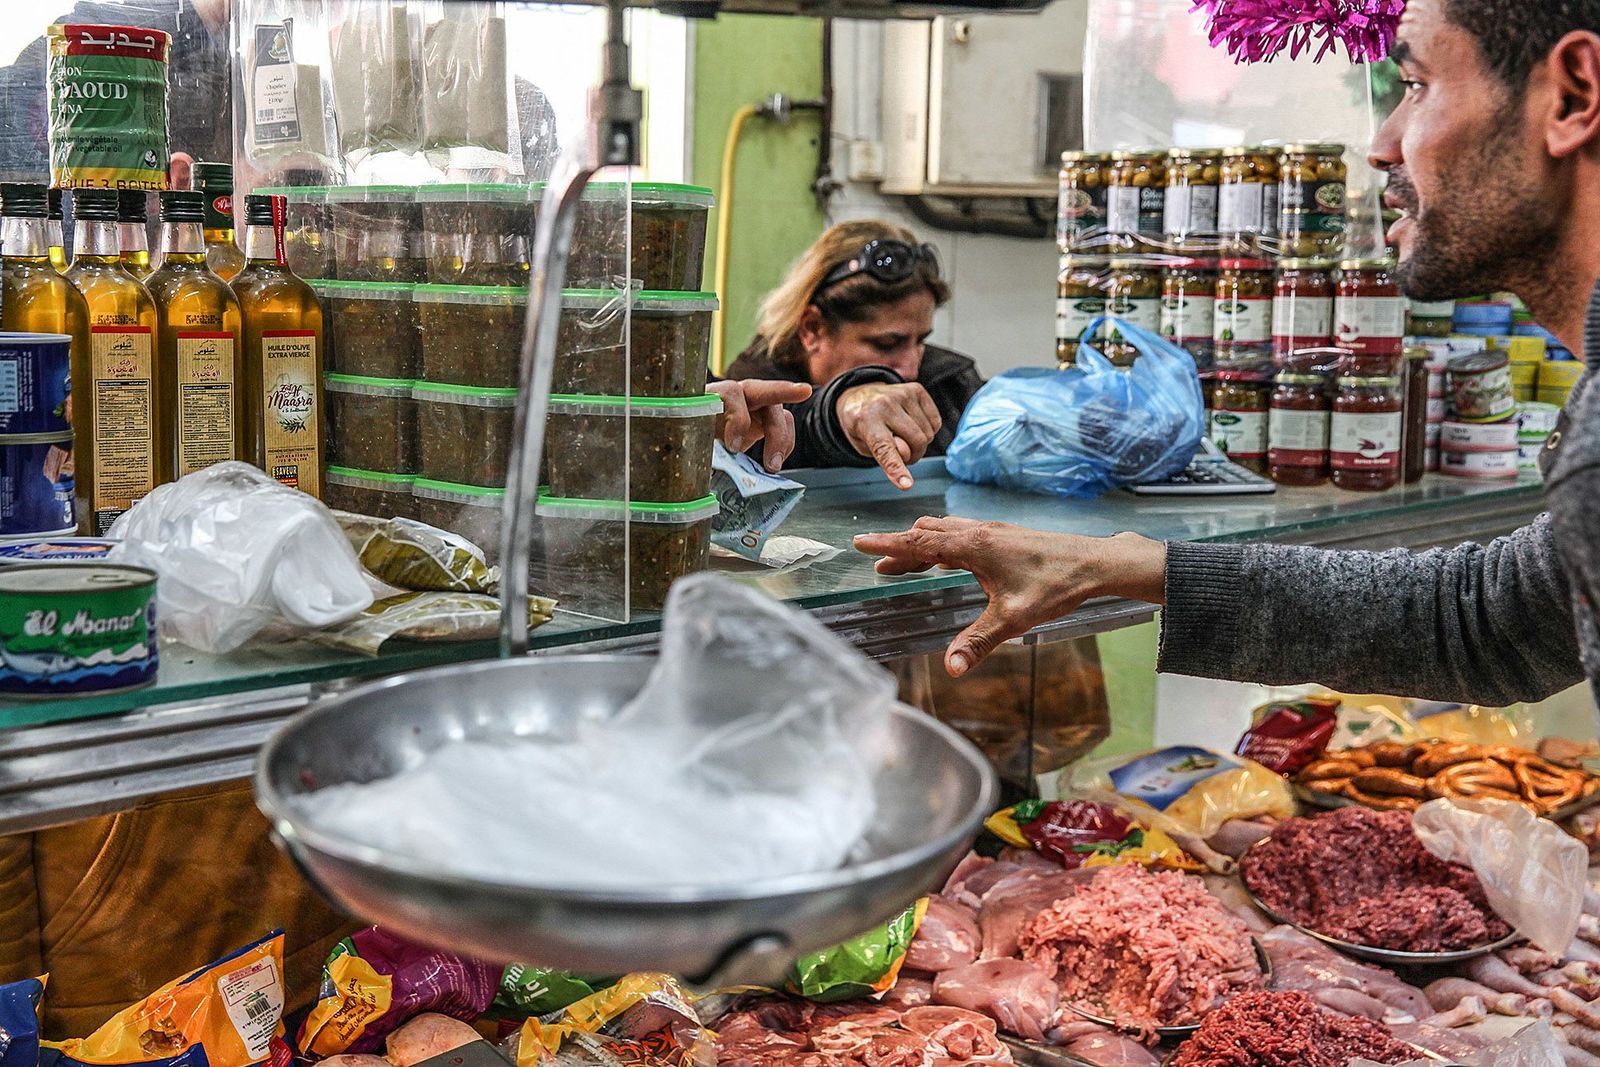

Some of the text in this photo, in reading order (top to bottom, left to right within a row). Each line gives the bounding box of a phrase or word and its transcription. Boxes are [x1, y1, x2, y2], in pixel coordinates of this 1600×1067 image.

[80, 31, 155, 53] جديد
[61, 81, 129, 99] AOUD
[24, 610, 58, 636] El
